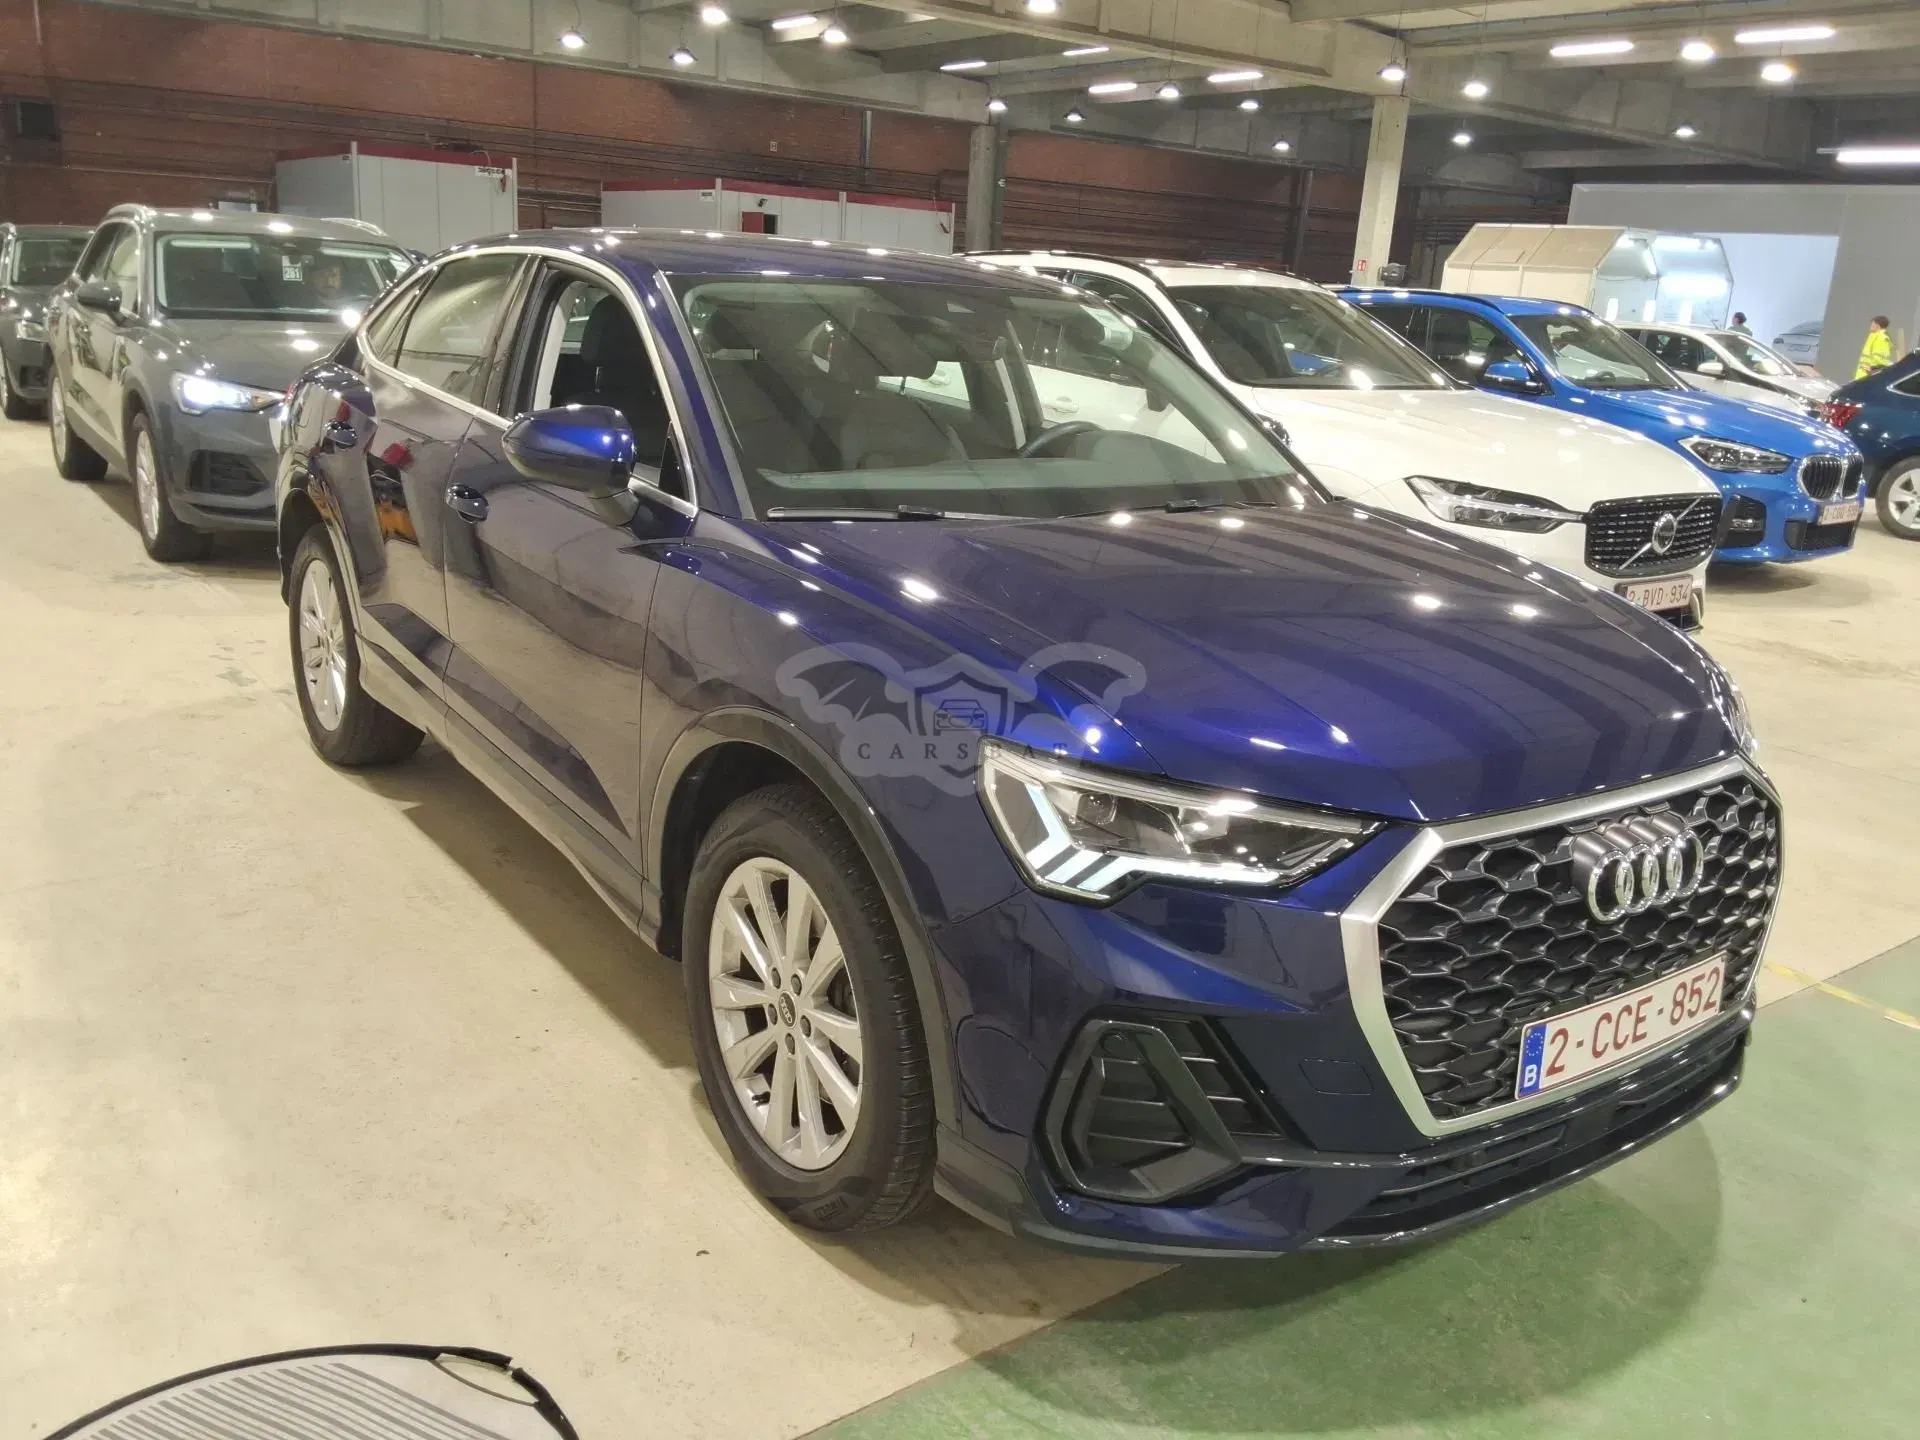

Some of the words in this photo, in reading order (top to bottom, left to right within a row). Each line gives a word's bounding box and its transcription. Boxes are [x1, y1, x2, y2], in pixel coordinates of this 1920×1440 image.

[1629, 583, 1690, 608] 2-BVD-934
[1545, 966, 1720, 1077] 2-CCE-852
[1523, 1064, 1537, 1087] B
